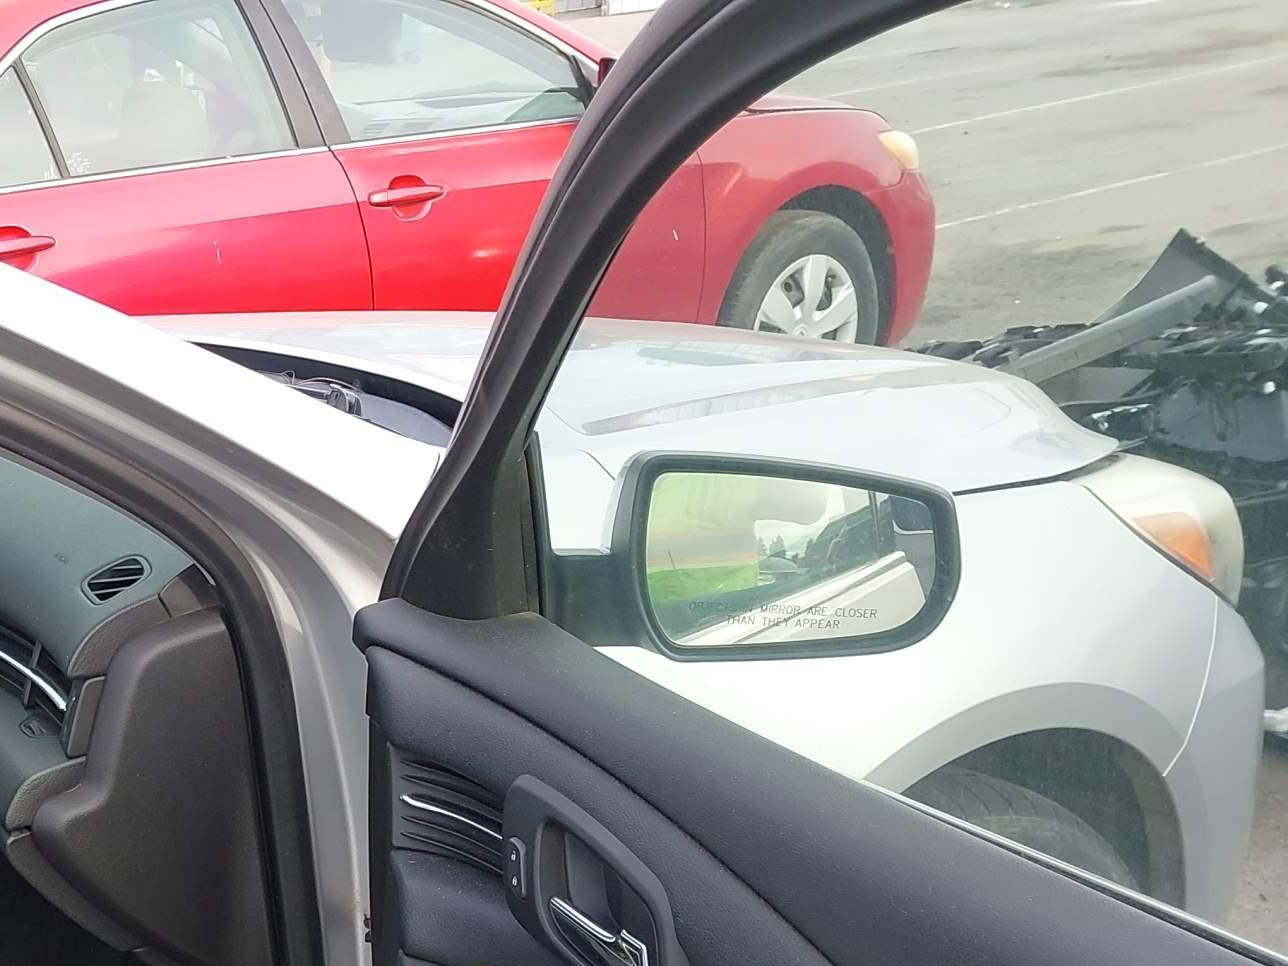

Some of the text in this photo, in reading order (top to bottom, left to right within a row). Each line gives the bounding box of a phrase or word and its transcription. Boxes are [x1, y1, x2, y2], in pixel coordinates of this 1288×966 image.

[760, 604, 801, 615] MIRROR
[807, 606, 829, 617] ARE
[835, 607, 878, 619] CLOSER
[726, 614, 841, 630] THAN THEY APPEAR
